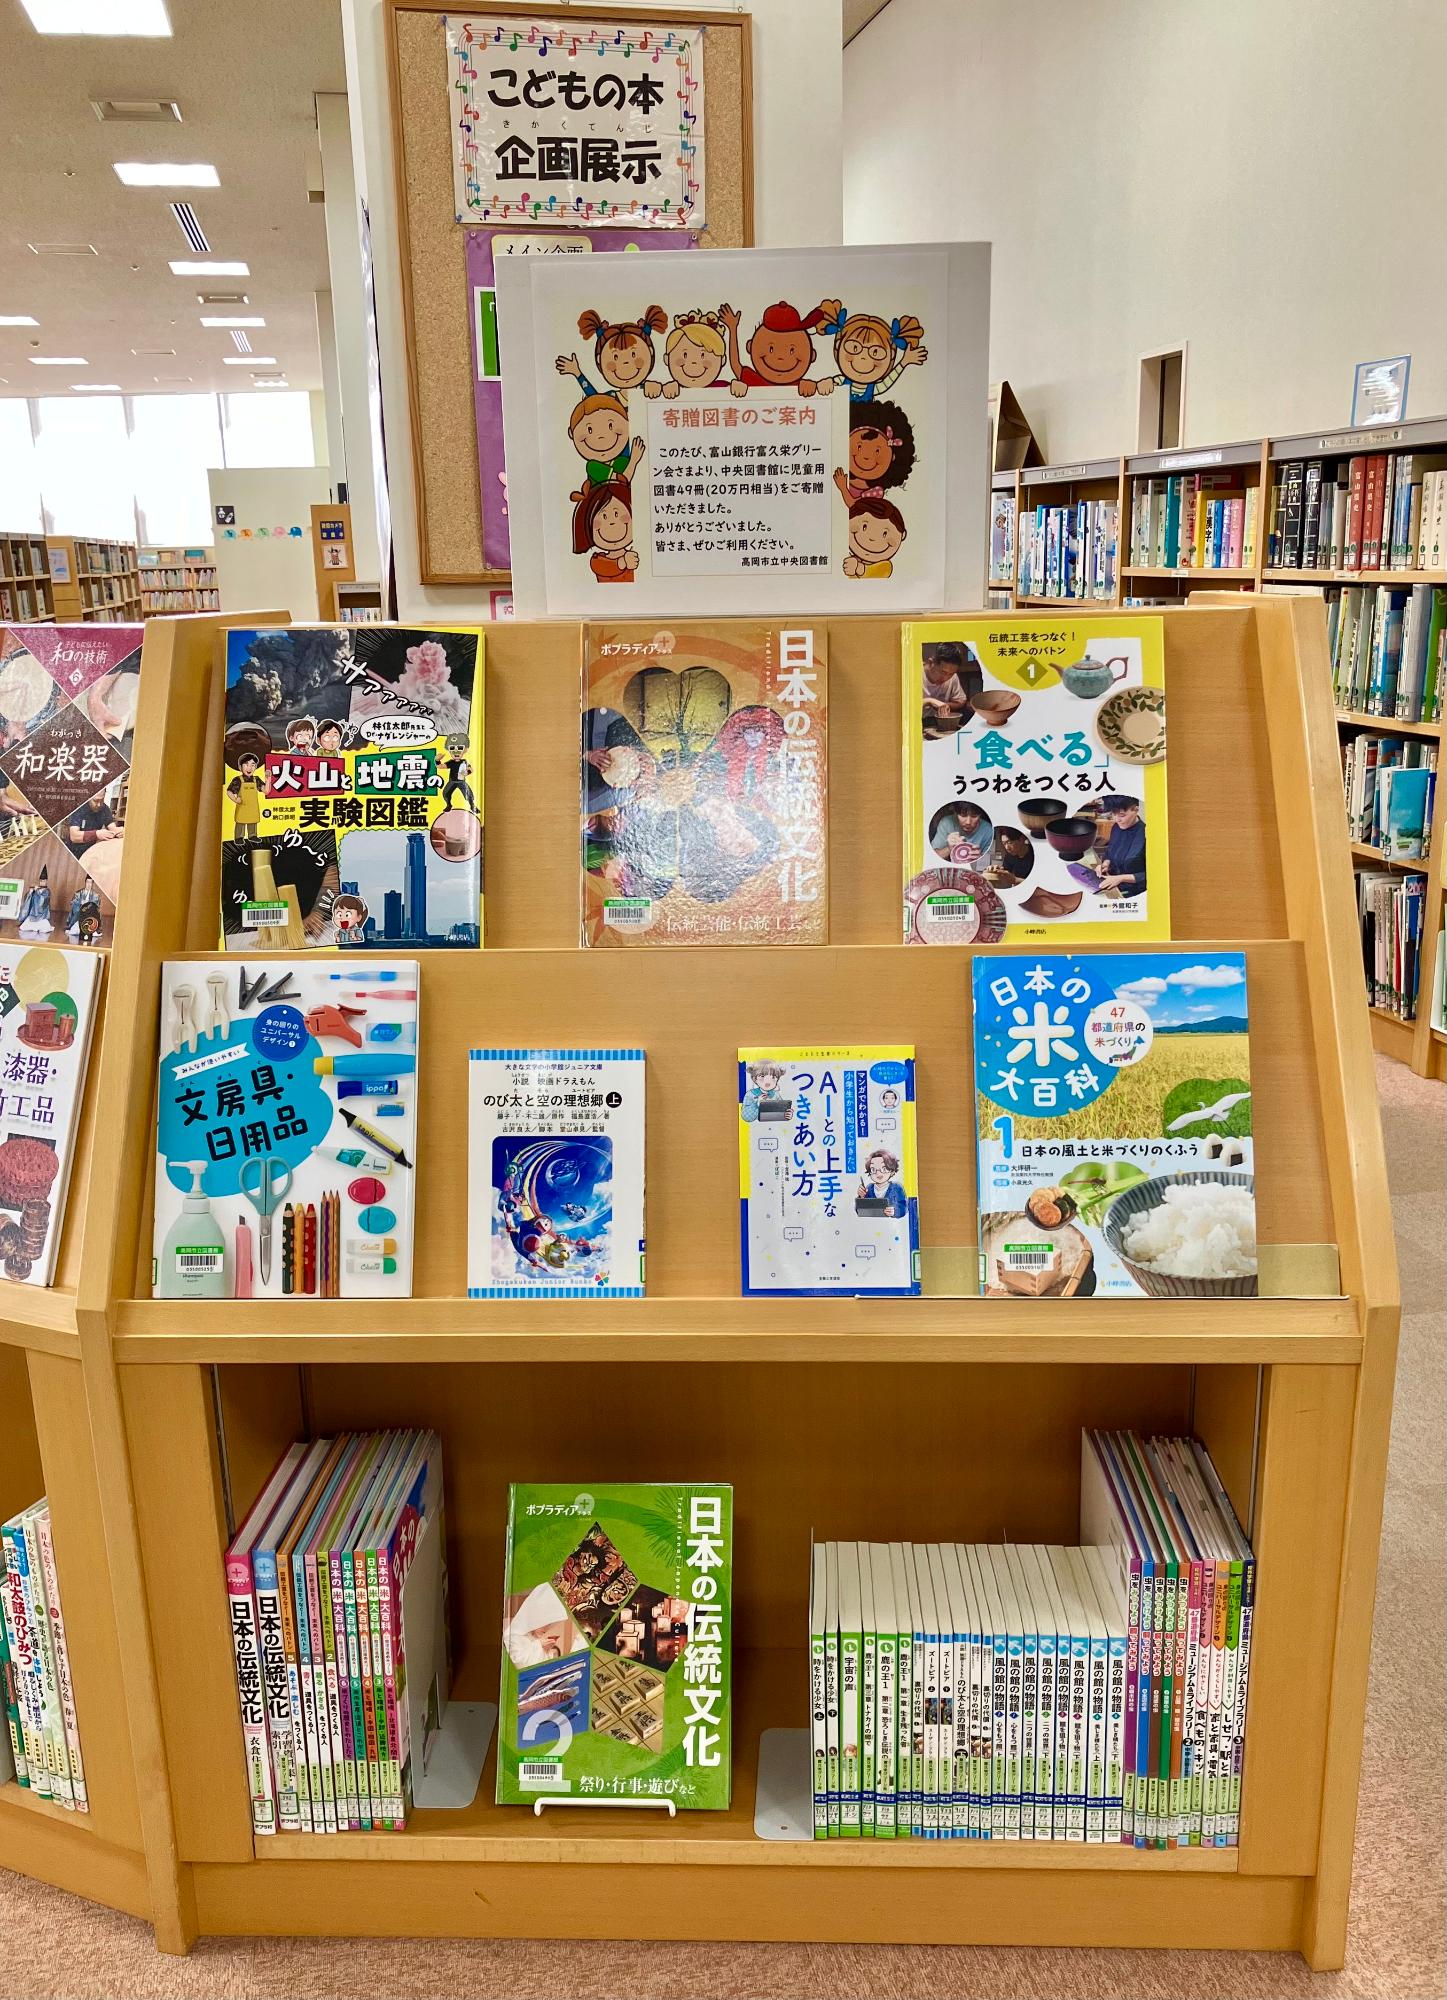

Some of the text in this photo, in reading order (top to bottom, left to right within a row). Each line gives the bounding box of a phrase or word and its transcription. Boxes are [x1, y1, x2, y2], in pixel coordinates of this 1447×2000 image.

[488, 69, 664, 114] こどもの本
[495, 135, 661, 185] 企画展示
[662, 405, 816, 429] 寄贈図書のご案内
[653, 463, 825, 478] ン会さまより、中央図書館に児童用
[659, 445, 822, 459] このたび、富山銀行富久栄グリー
[653, 481, 824, 497] 図書49冊(20万円相当)をご寄贈
[654, 501, 732, 515] いただきました。
[655, 520, 772, 533] ありがとうございました。
[656, 538, 795, 552] 皆さま、ぜひご利用ください。
[741, 556, 828, 567] 高岡市立中央図書館
[50, 642, 108, 664] 和の技術
[998, 647, 1066, 656] 未来へのバトン
[14, 742, 110, 783] 和楽器
[958, 731, 1109, 771] 「食べる」
[271, 756, 444, 792] 火山と地震の
[953, 772, 1116, 795] うつわをつくる人
[299, 798, 429, 828] 実験図鑑
[990, 964, 1091, 1006] 日本の
[1091, 1022, 1146, 1032] 都道府県の
[1110, 1007, 1125, 1017] 47
[261, 1028, 300, 1039] ユニバーサル
[1006, 1001, 1080, 1067] 米
[1095, 1036, 1131, 1047] 米づくり
[484, 1094, 603, 1107] のび太と空の理想郷
[990, 1063, 1099, 1107] 大百科
[206, 1105, 309, 1161] 日用品
[792, 1073, 816, 1197] つきあい方
[992, 1115, 1013, 1159] 1
[1022, 1144, 1198, 1157] 日本の風土と米づくりのくふう
[525, 1504, 578, 1516] ポプラディア
[331, 1559, 345, 1632] 日本の米大百科
[343, 1560, 356, 1633] 日本の米大百科
[355, 1559, 369, 1632] 日本の米大百科
[367, 1557, 380, 1631] 日本の米大百科
[378, 1557, 391, 1631] 日本の米大百科
[7, 1572, 32, 1665] 和太鼓のひみつ
[682, 1497, 724, 1768] 日本の伝統文化
[232, 1601, 263, 1724] 日本の伝統文化
[258, 1596, 290, 1719] 日本の伝統文化
[844, 1657, 854, 1692] 宇宙の声
[928, 1651, 936, 1682] ズートピア
[943, 1651, 951, 1682] ズートピア
[813, 1658, 822, 1709] 時をかける少女
[826, 1656, 835, 1703] 時をかける少女
[994, 1657, 1005, 1711] 風の館の物語
[1009, 1659, 1021, 1712] 風の館の物語
[1024, 1657, 1036, 1710] 風の館の物語
[1042, 1658, 1053, 1711] 風の館の物語
[1058, 1658, 1069, 1712] 風の館の物語
[1073, 1660, 1084, 1713] 風の館の物語
[1093, 1661, 1104, 1713] 風の館の物語
[1112, 1659, 1124, 1712] 風の館の物語
[579, 1775, 696, 1795] 祭り・行事・遊びなど
